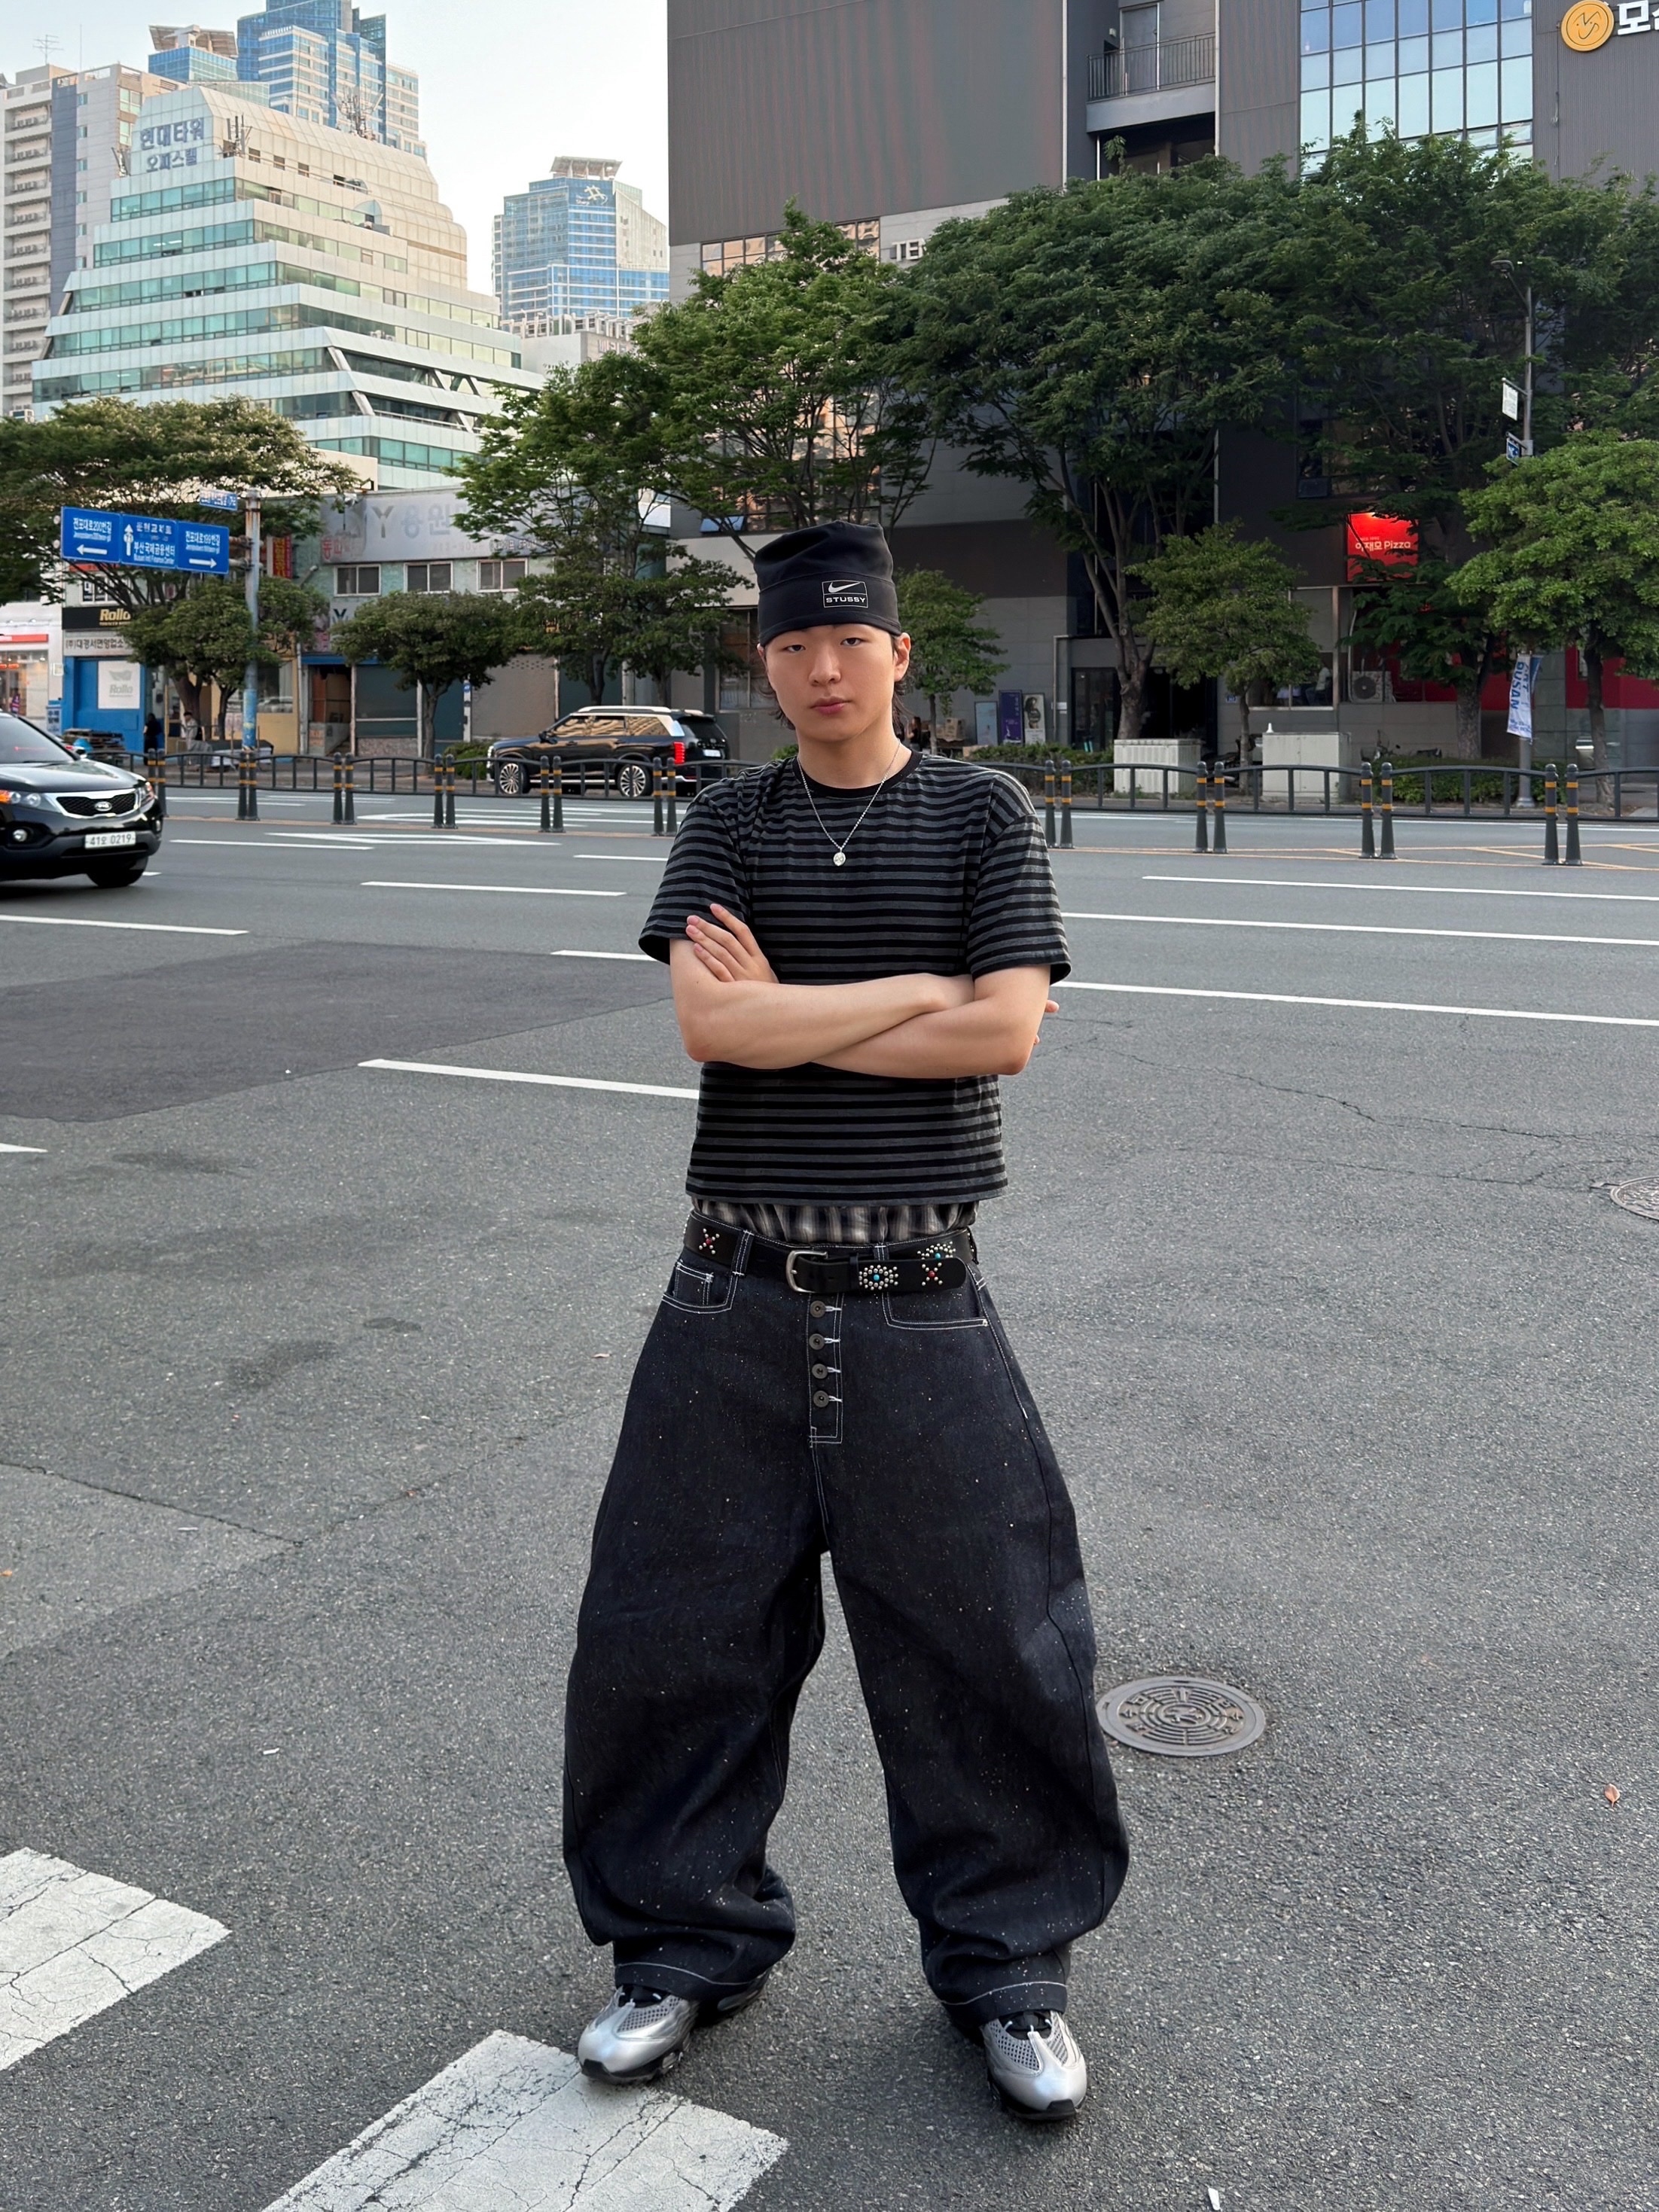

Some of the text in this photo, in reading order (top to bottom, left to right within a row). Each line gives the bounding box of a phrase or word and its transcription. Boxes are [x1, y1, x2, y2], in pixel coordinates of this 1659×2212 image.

[1617, 0, 1659, 35] 모
[140, 117, 204, 151] 현대타워
[146, 148, 197, 173] 오피스텔
[1384, 541, 1410, 549] Pizza
[99, 608, 131, 621] Rollo
[1511, 661, 1524, 710] BUSAN
[111, 833, 131, 844] 0219
